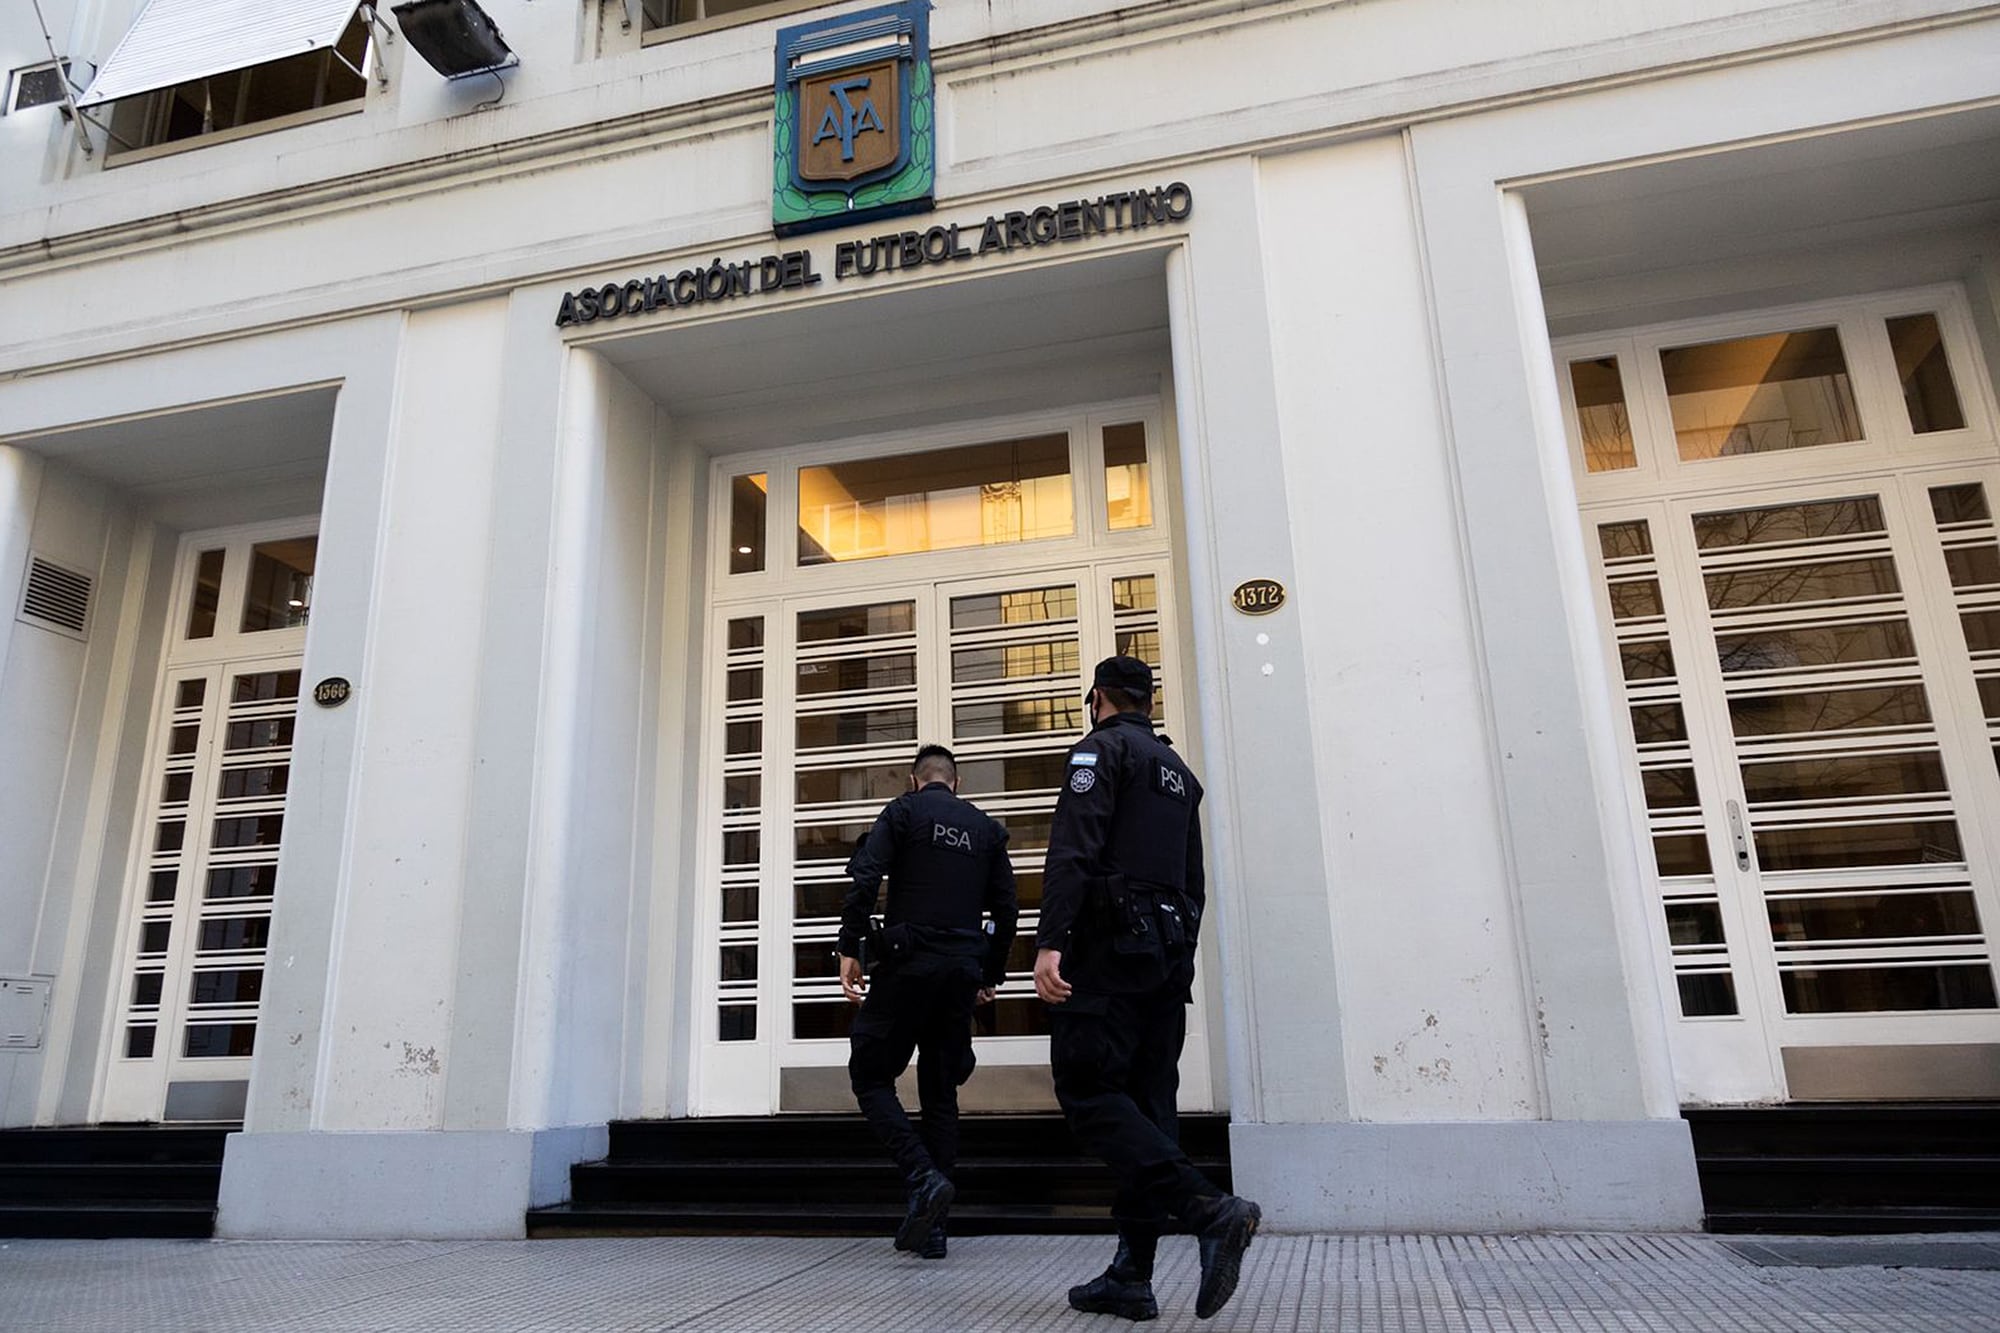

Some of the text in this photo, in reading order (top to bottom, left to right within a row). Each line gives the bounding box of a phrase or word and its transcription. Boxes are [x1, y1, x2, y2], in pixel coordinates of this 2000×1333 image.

[556, 181, 1193, 327] ASOCIACIÓN DEL FUTBOL ARGENTINO
[1239, 585, 1279, 606] 1372
[318, 683, 346, 700] 1366
[1160, 766, 1185, 796] PSA
[932, 823, 972, 850] PSA
